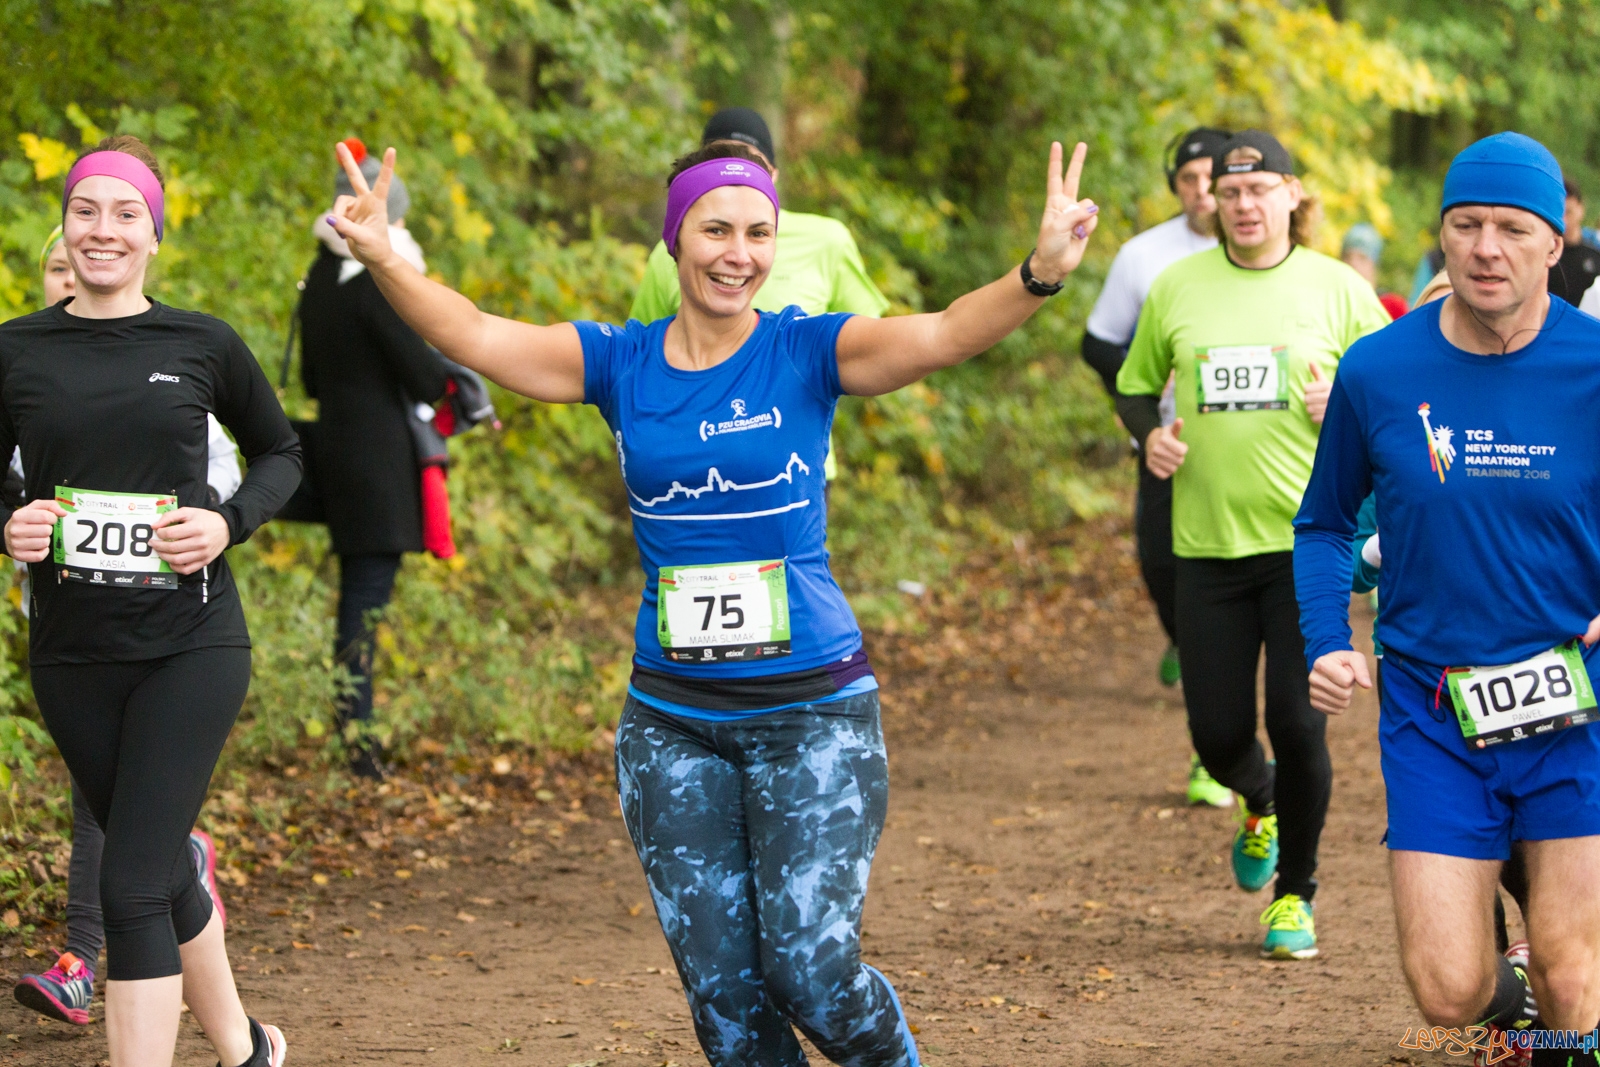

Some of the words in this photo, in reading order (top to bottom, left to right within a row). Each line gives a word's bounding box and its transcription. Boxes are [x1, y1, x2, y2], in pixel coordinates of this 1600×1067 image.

[1214, 366, 1269, 391] 987
[718, 420, 734, 430] PZU
[734, 413, 773, 427] CRACOVIA
[1464, 429, 1494, 441] TCS
[1464, 444, 1493, 453] NEW
[1494, 444, 1527, 454] YORK
[1528, 445, 1557, 456] CITY
[1464, 455, 1530, 467] MARATHON
[1464, 467, 1521, 478] TRAINING
[1523, 469, 1551, 480] 2016
[76, 519, 154, 558] 208
[99, 559, 127, 569] KASIA
[693, 593, 745, 631] 75
[689, 634, 718, 645] MAMA
[1469, 664, 1573, 717] 1028
[1512, 708, 1545, 723] PAWEŁ
